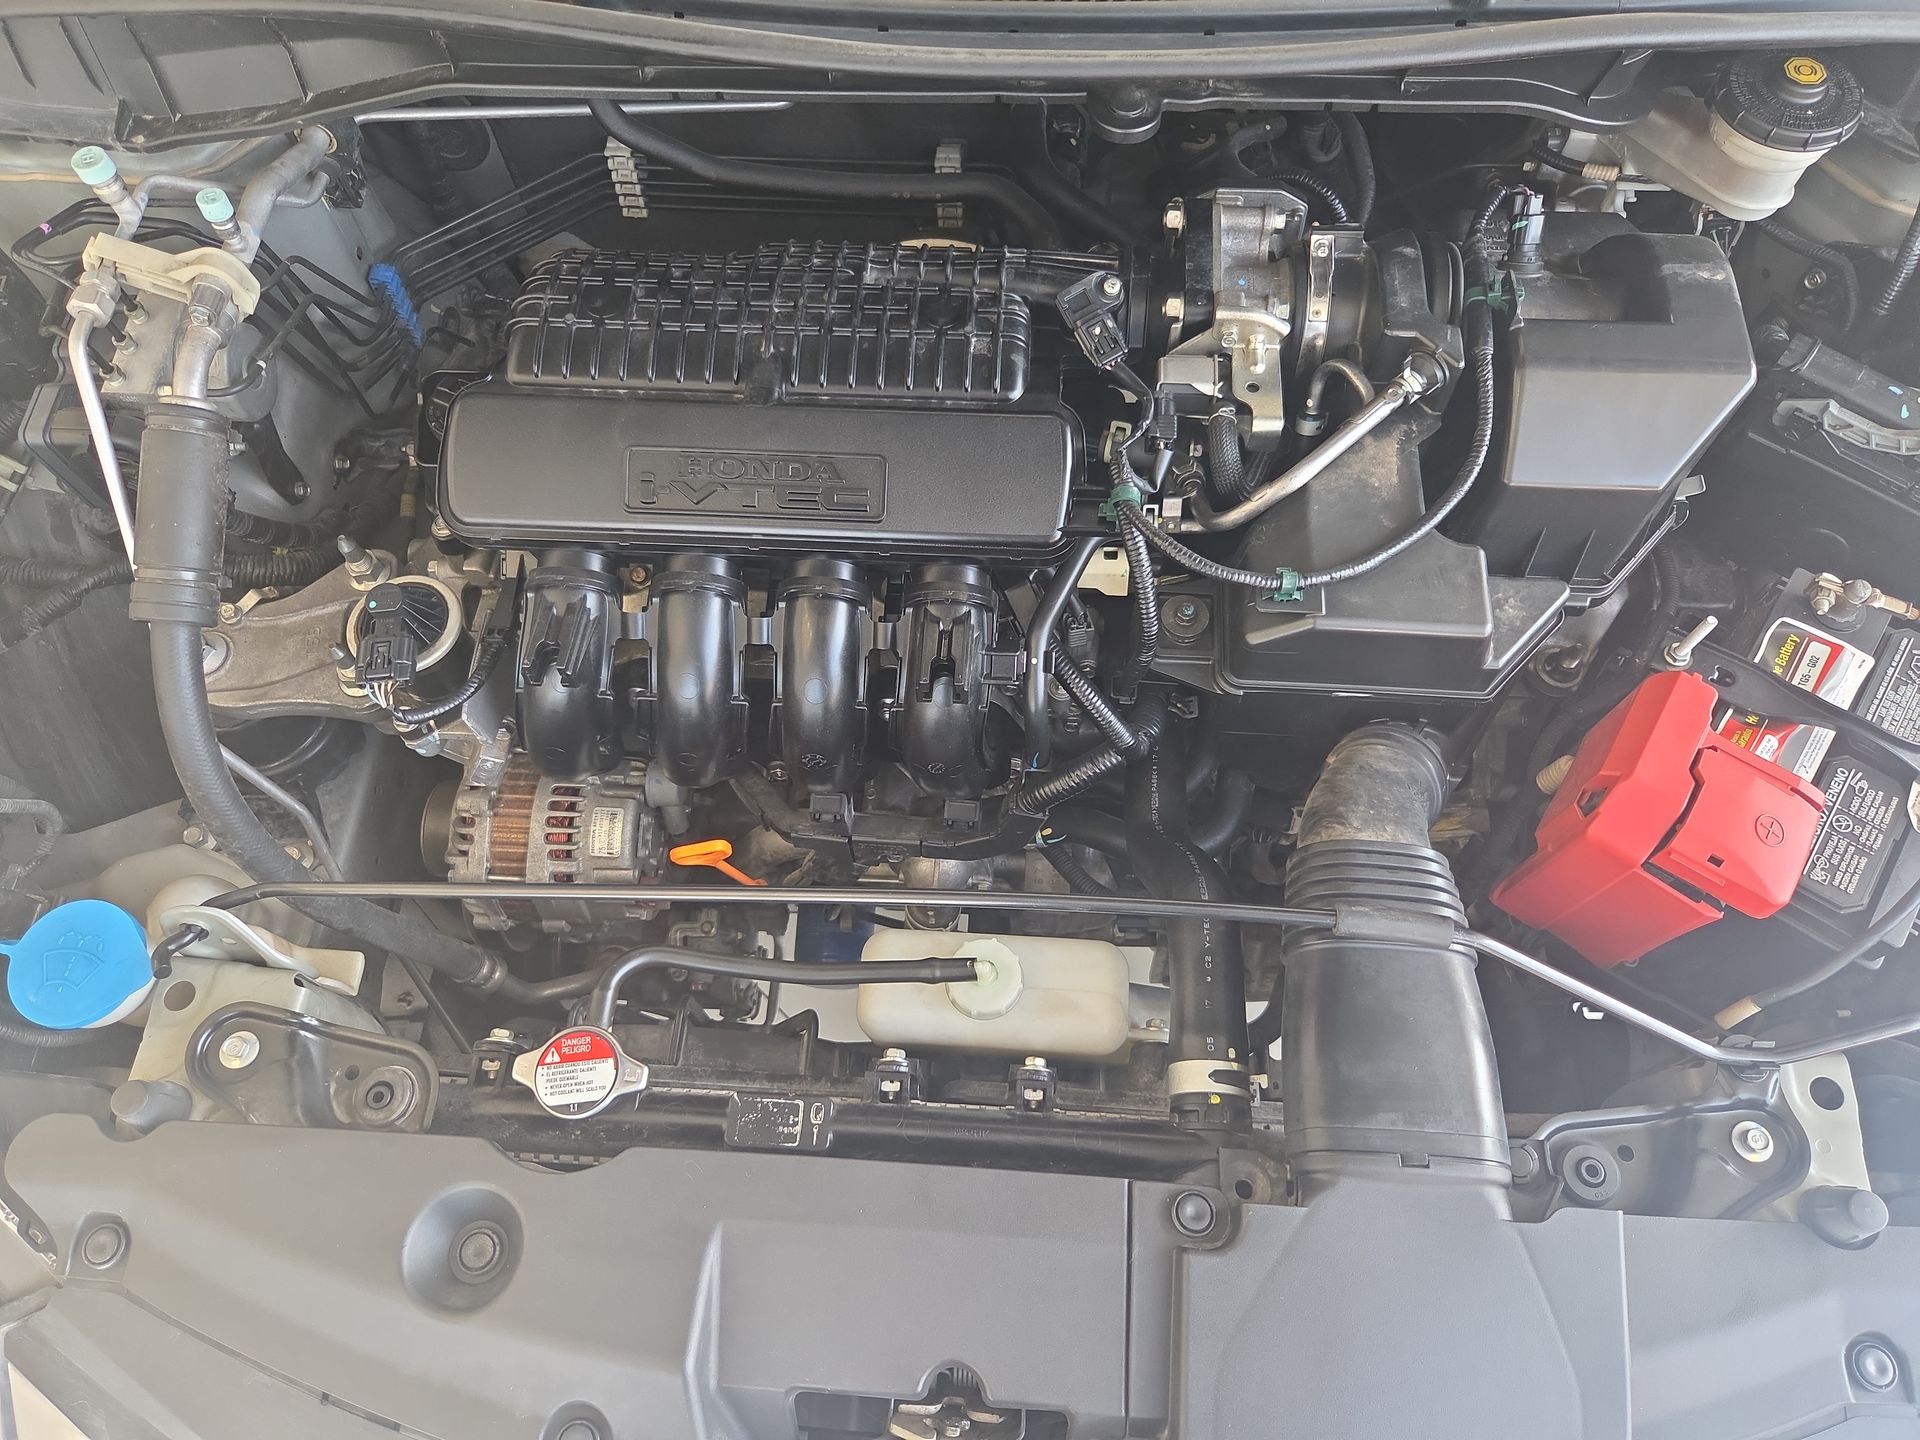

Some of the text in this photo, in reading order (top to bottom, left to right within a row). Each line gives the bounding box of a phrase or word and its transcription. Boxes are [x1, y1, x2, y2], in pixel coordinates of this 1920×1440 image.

[678, 457, 846, 484] HONDA
[640, 472, 870, 512] i-VTEC
[1776, 633, 1801, 666] Battery
[1798, 653, 1821, 688] TG5-G02
[1825, 768, 1849, 807] VENENO
[1853, 825, 1863, 836] NO
[1822, 834, 1839, 858] PROTEJA
[1831, 839, 1848, 865] SUS OJOS
[562, 1036, 591, 1046] DANGER
[562, 1045, 591, 1054] PELIGRO
[1206, 1036, 1215, 1051] 05
[552, 1068, 578, 1076] REFRIGERANTE
